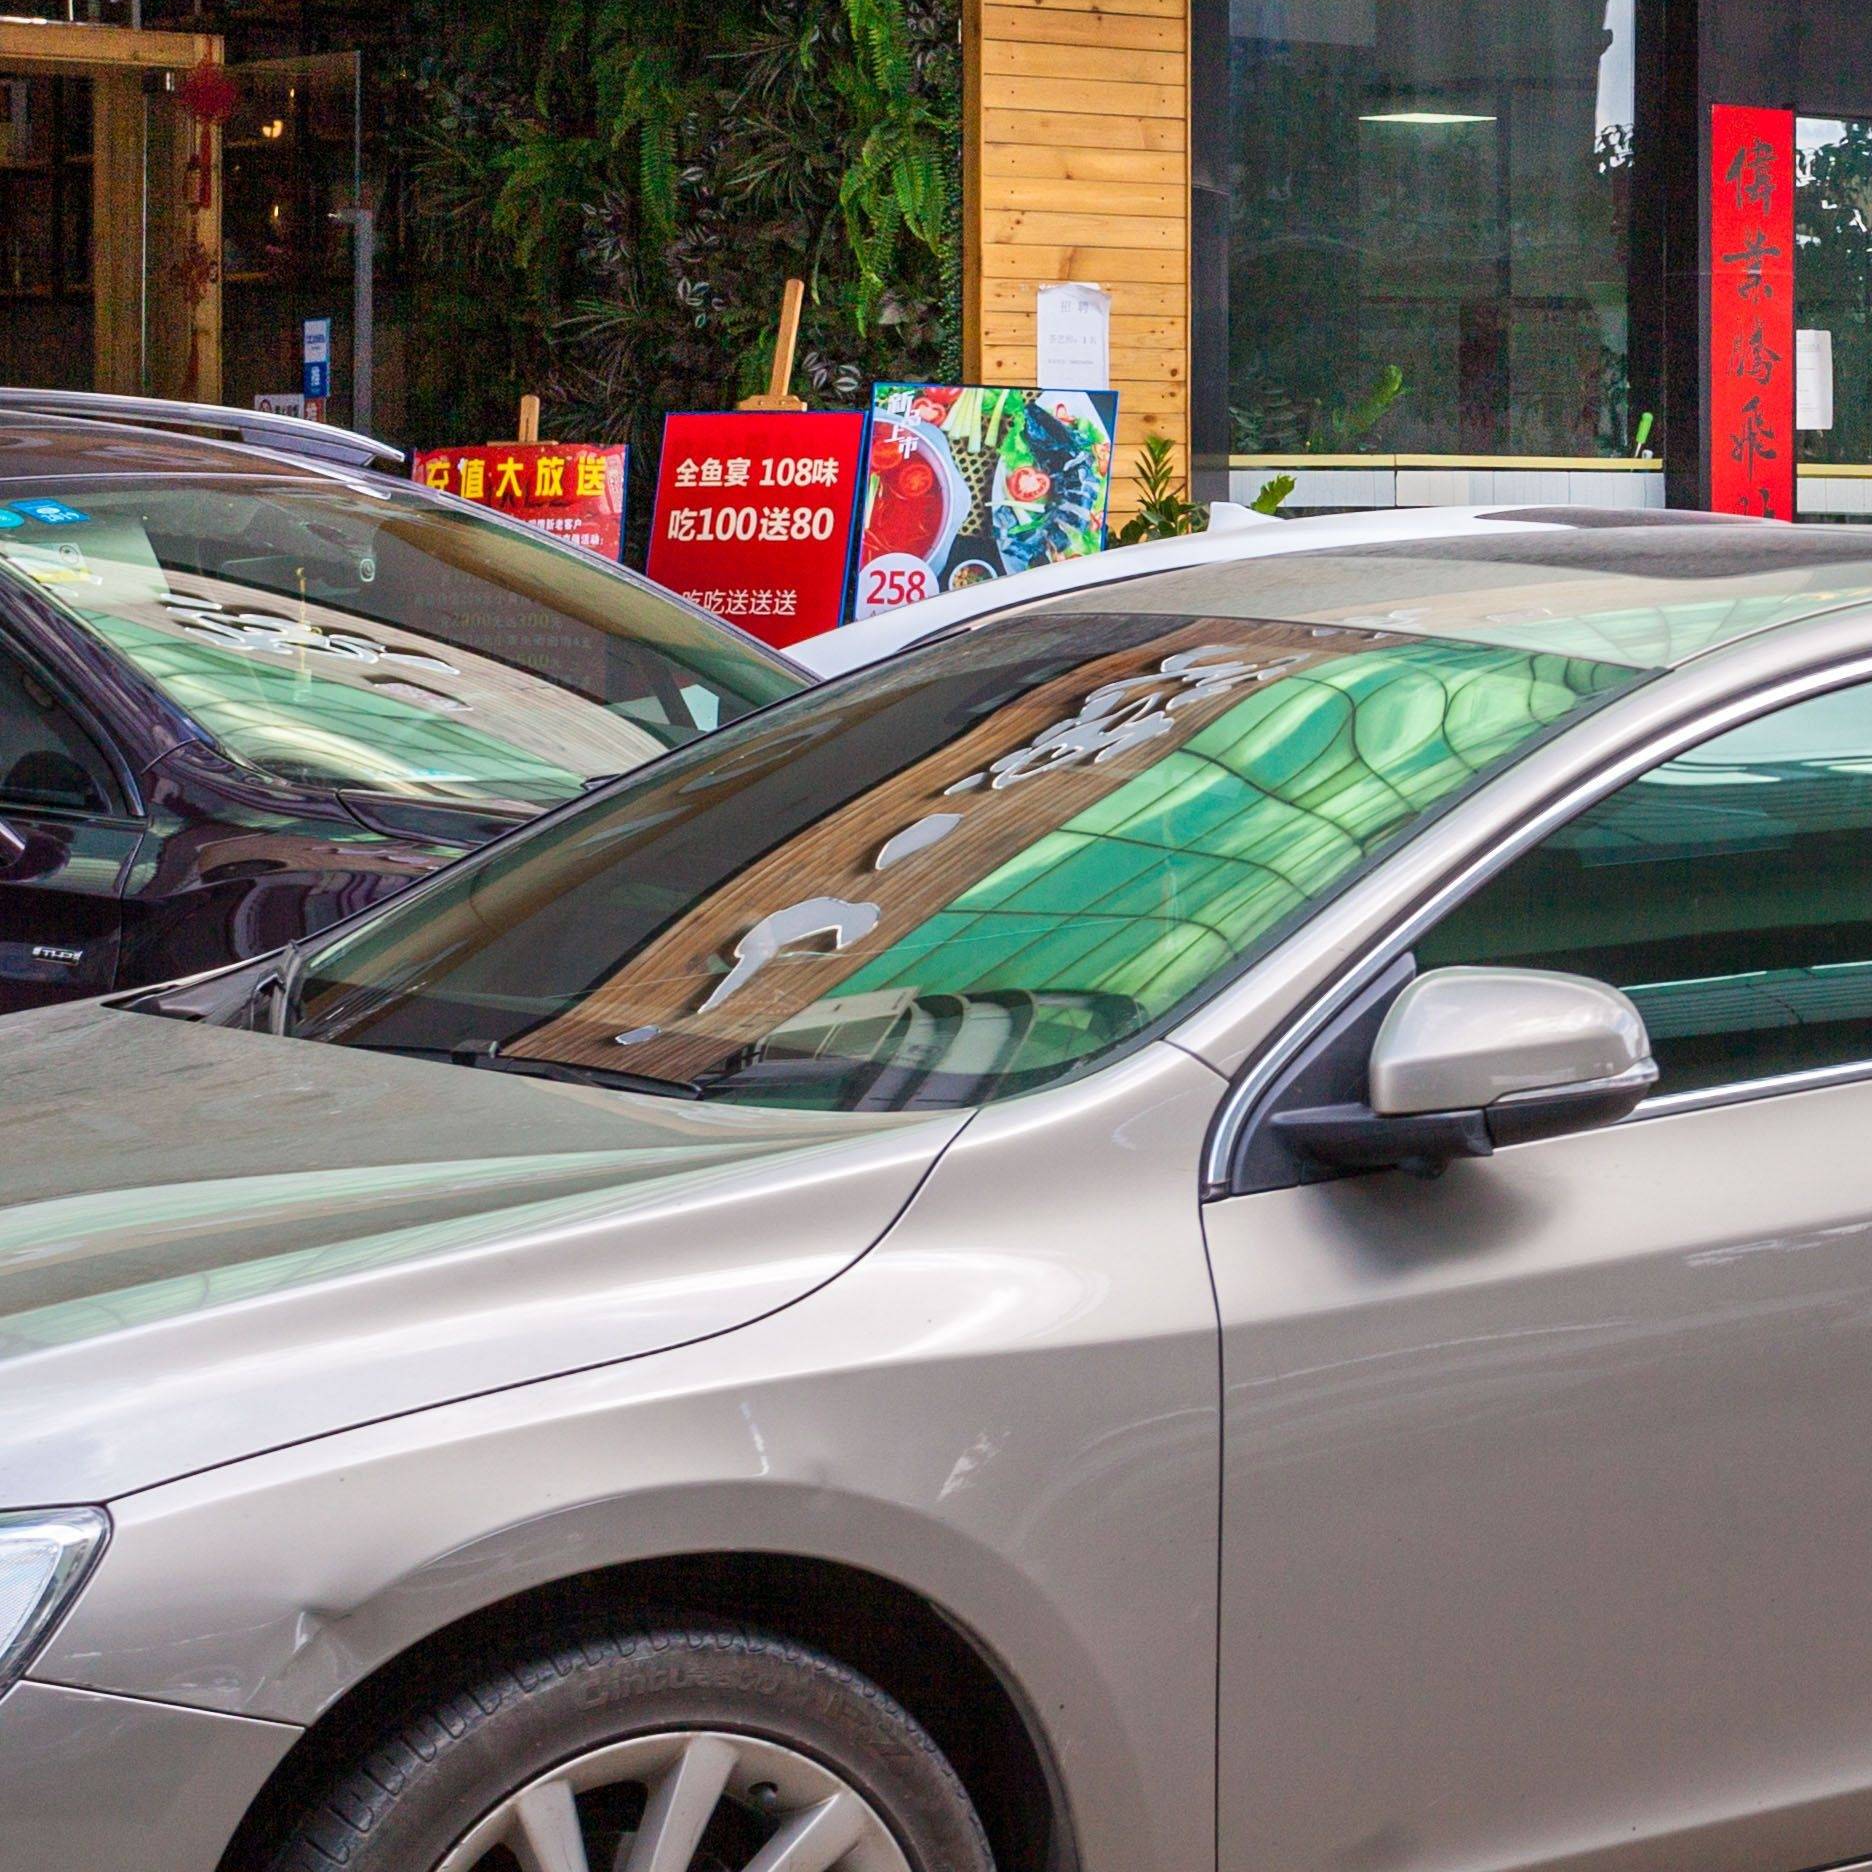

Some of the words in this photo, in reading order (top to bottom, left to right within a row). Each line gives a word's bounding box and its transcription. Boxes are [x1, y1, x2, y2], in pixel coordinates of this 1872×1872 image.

[674, 457, 751, 487] 全鱼宴
[759, 457, 839, 488] 108味
[667, 506, 835, 542] 吃100送80
[866, 570, 926, 605] 258
